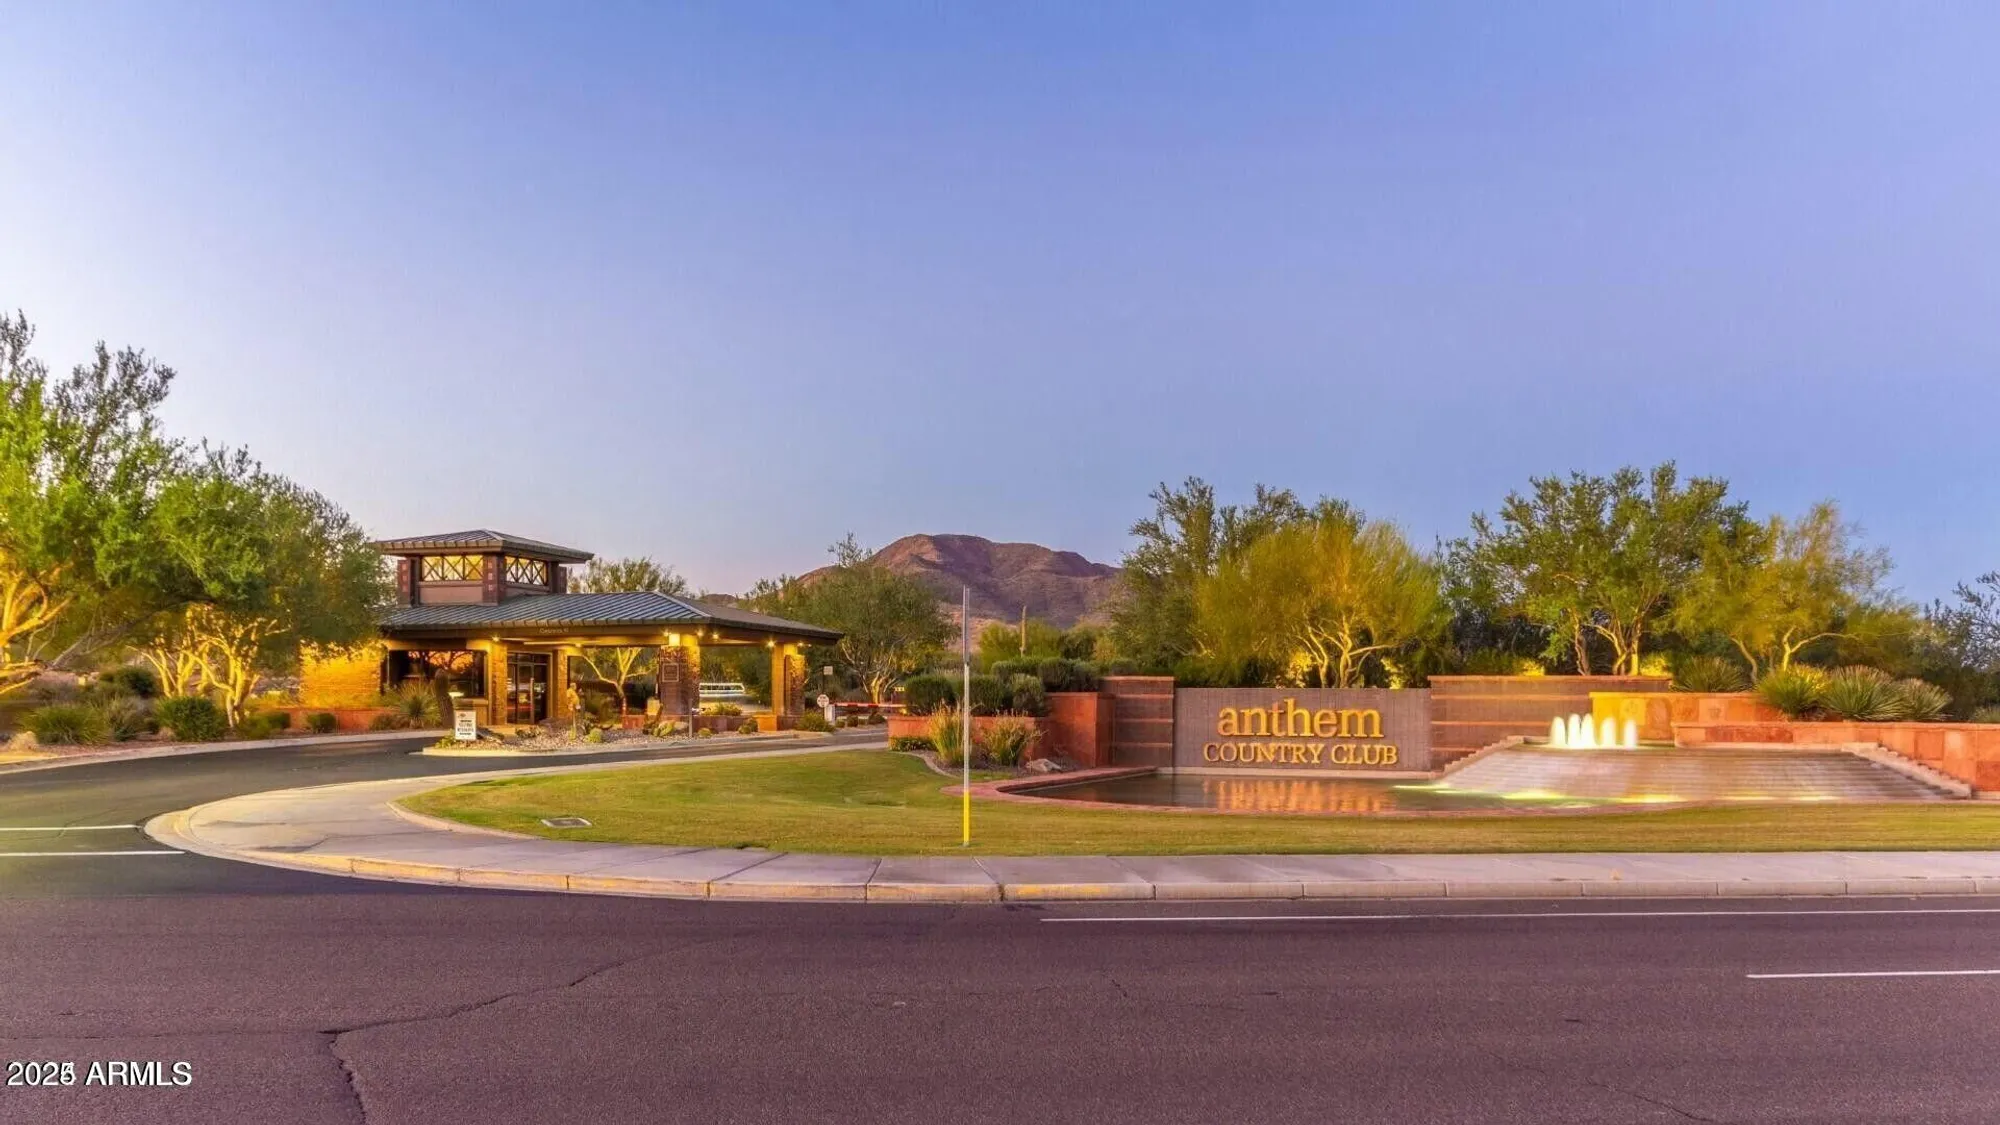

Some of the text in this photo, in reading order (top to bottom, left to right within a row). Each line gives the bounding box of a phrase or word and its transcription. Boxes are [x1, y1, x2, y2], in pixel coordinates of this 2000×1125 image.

[1217, 698, 1385, 738] anthem
[1203, 742, 1398, 765] COUNTRY CLUB
